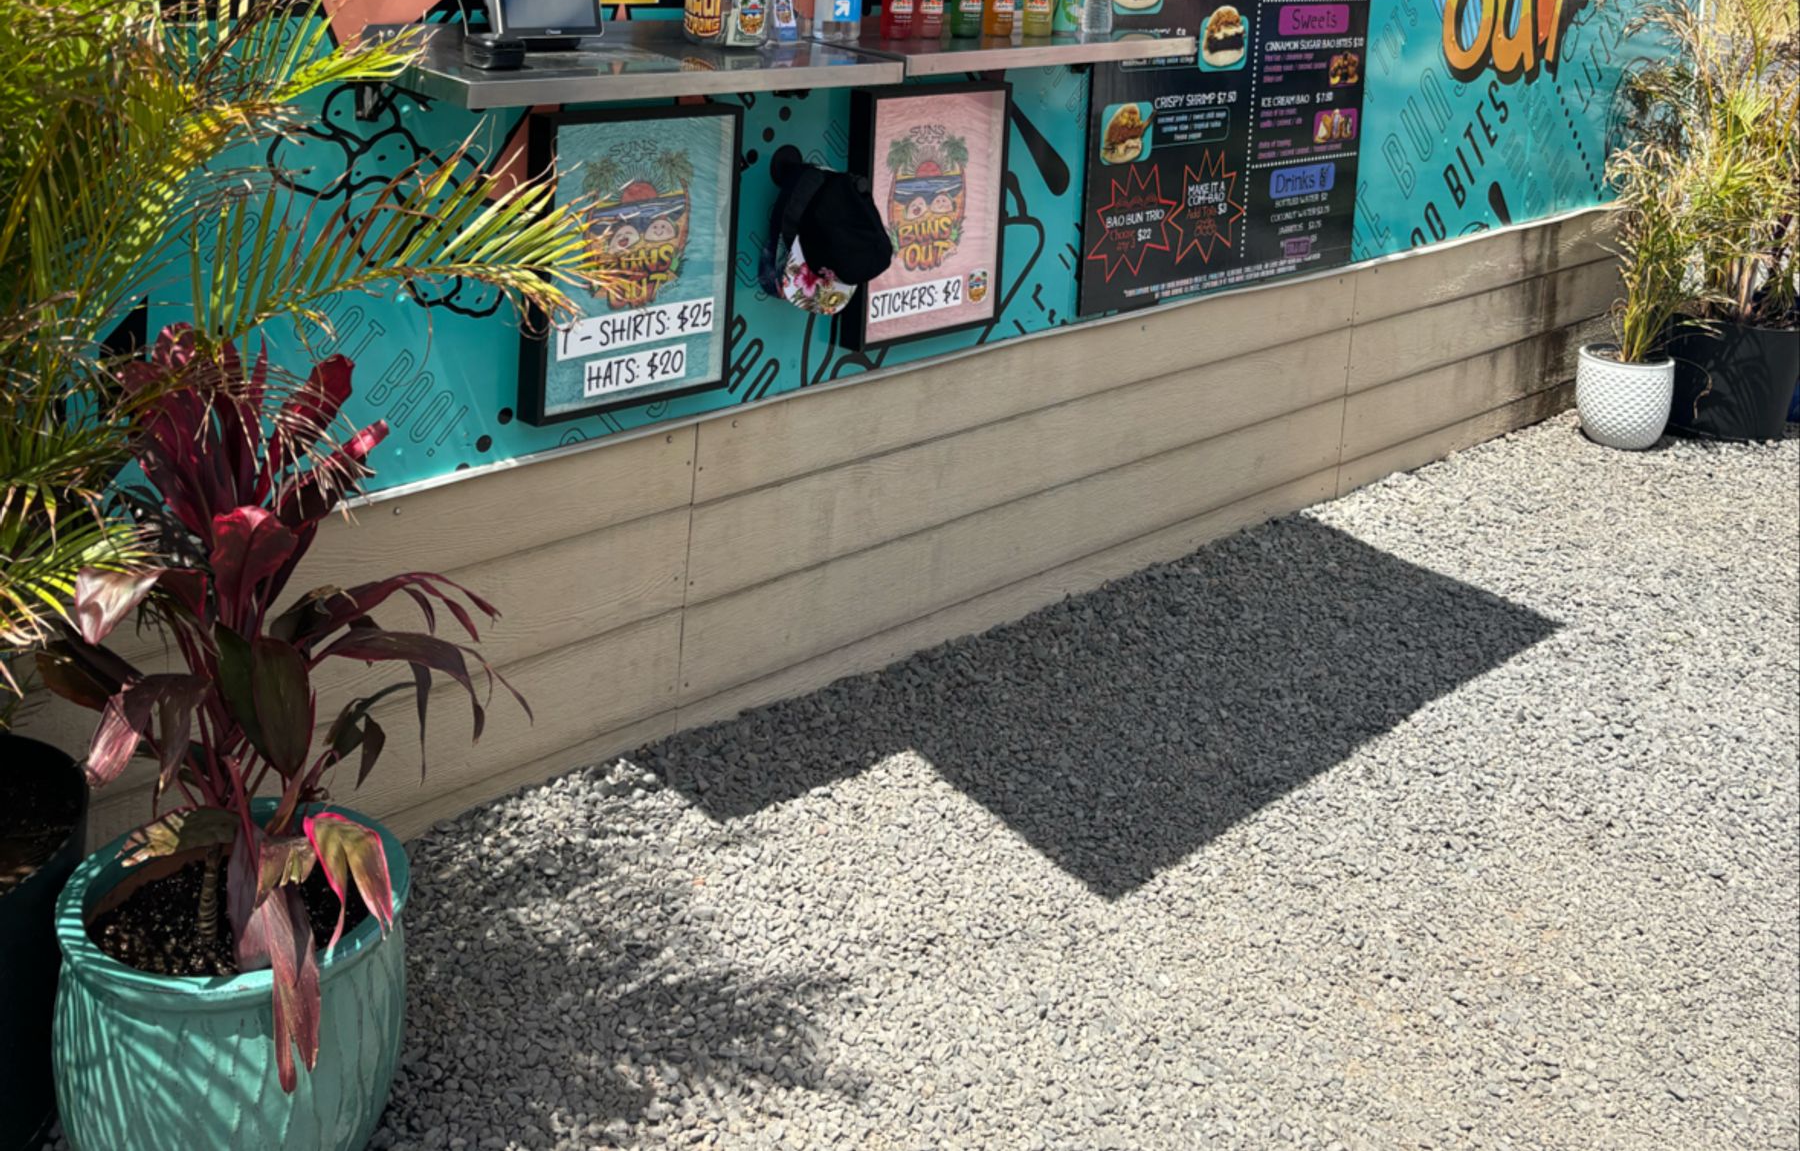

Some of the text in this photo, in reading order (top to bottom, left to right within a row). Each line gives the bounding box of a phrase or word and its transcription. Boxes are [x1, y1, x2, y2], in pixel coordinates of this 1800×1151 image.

[1292, 9, 1337, 31] Sweets
[1265, 40, 1299, 52] CINNAMON
[1300, 39, 1322, 50] SUGAR
[1322, 39, 1335, 49] BAO
[1154, 91, 1238, 110] CRISPY SHRIMP $7.50
[1261, 97, 1272, 108] ICE
[1273, 95, 1295, 106] CREAM
[1296, 94, 1309, 105] BAO
[909, 124, 946, 139] SUNS
[916, 134, 945, 145] OUT
[1443, 79, 1509, 211] BITES
[1188, 181, 1226, 196] MAKE IT A
[1275, 170, 1315, 194] Drinks
[1106, 209, 1165, 229] BAO BUN TRIO
[898, 216, 953, 247] BUNS
[1137, 228, 1152, 242] $22
[903, 240, 950, 272] OUT
[870, 279, 962, 319] STICKERS: $2
[559, 327, 571, 355] T
[599, 309, 671, 347] SHIRTS:
[677, 301, 713, 332] $25
[587, 350, 684, 392] HATS: $20
[365, 348, 469, 457] BAO!
